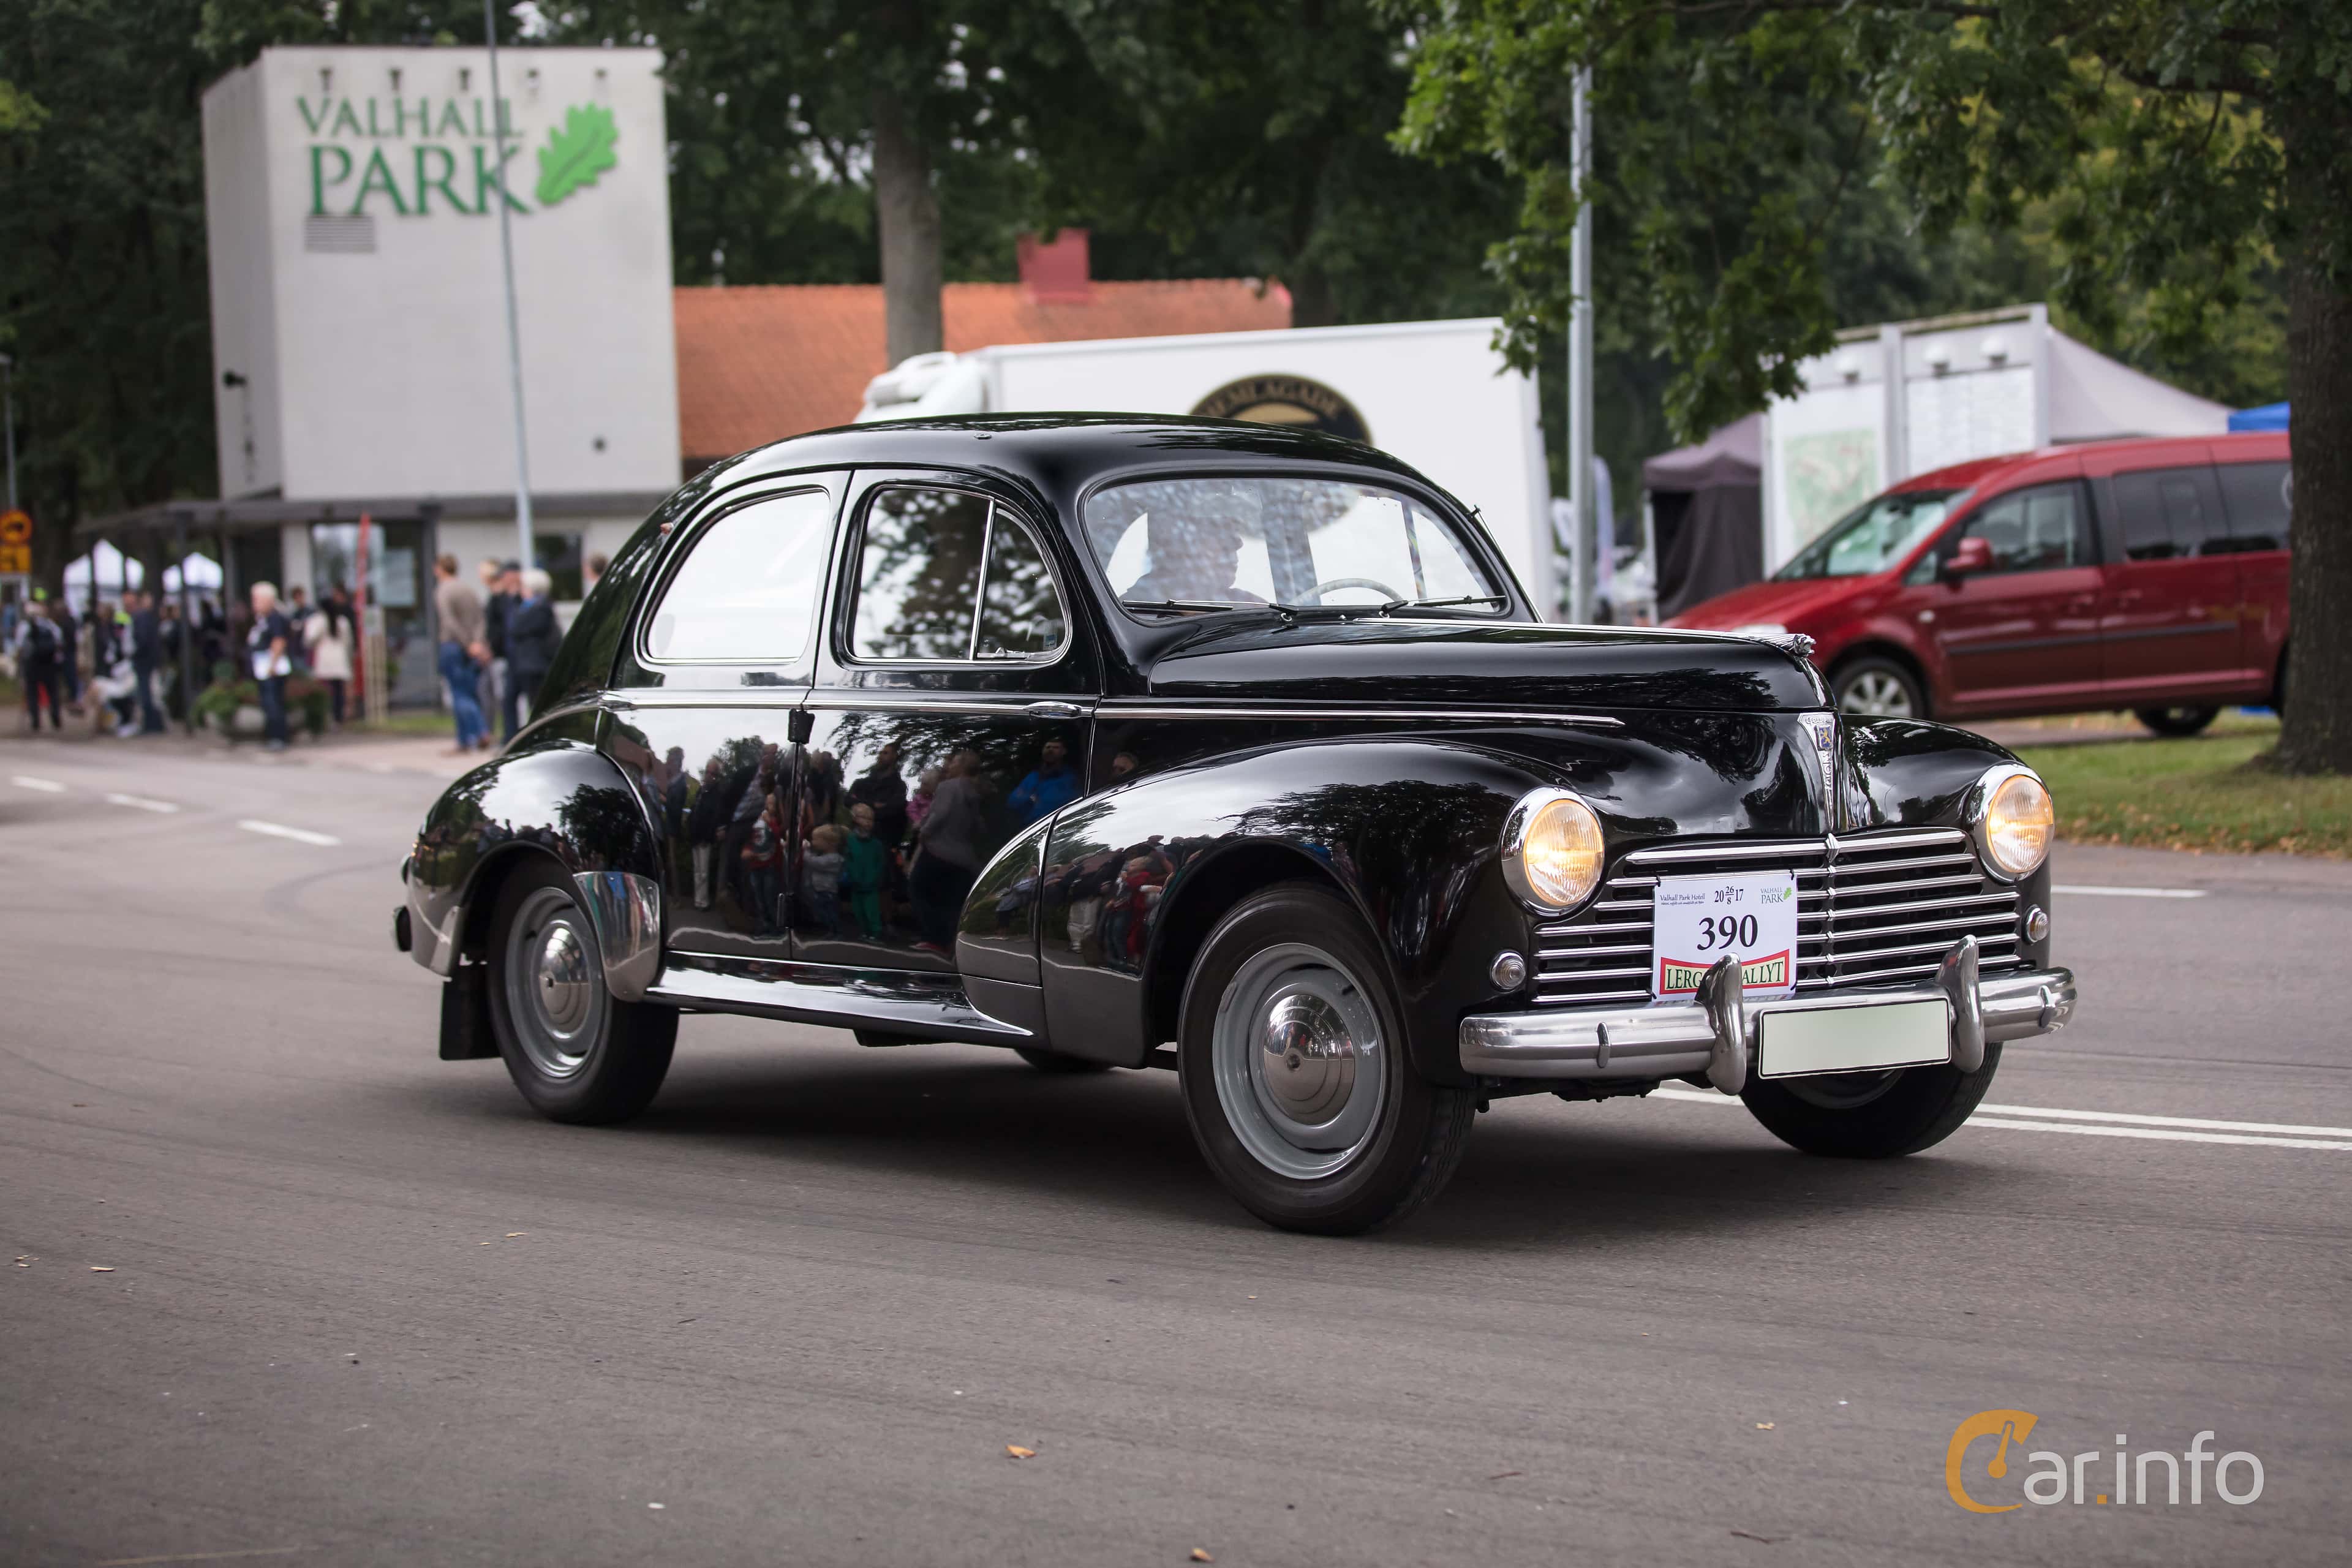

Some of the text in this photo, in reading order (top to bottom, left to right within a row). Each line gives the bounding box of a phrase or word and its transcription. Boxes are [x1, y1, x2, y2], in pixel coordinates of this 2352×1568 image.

[296, 96, 524, 137] VALHALL
[309, 145, 533, 216] PARK
[1714, 890, 1724, 903] 20
[1735, 889, 1744, 901] 17
[1761, 893, 1784, 904] PARK
[1697, 914, 1758, 951] 390
[1666, 962, 1784, 989] LERG ALLYT
